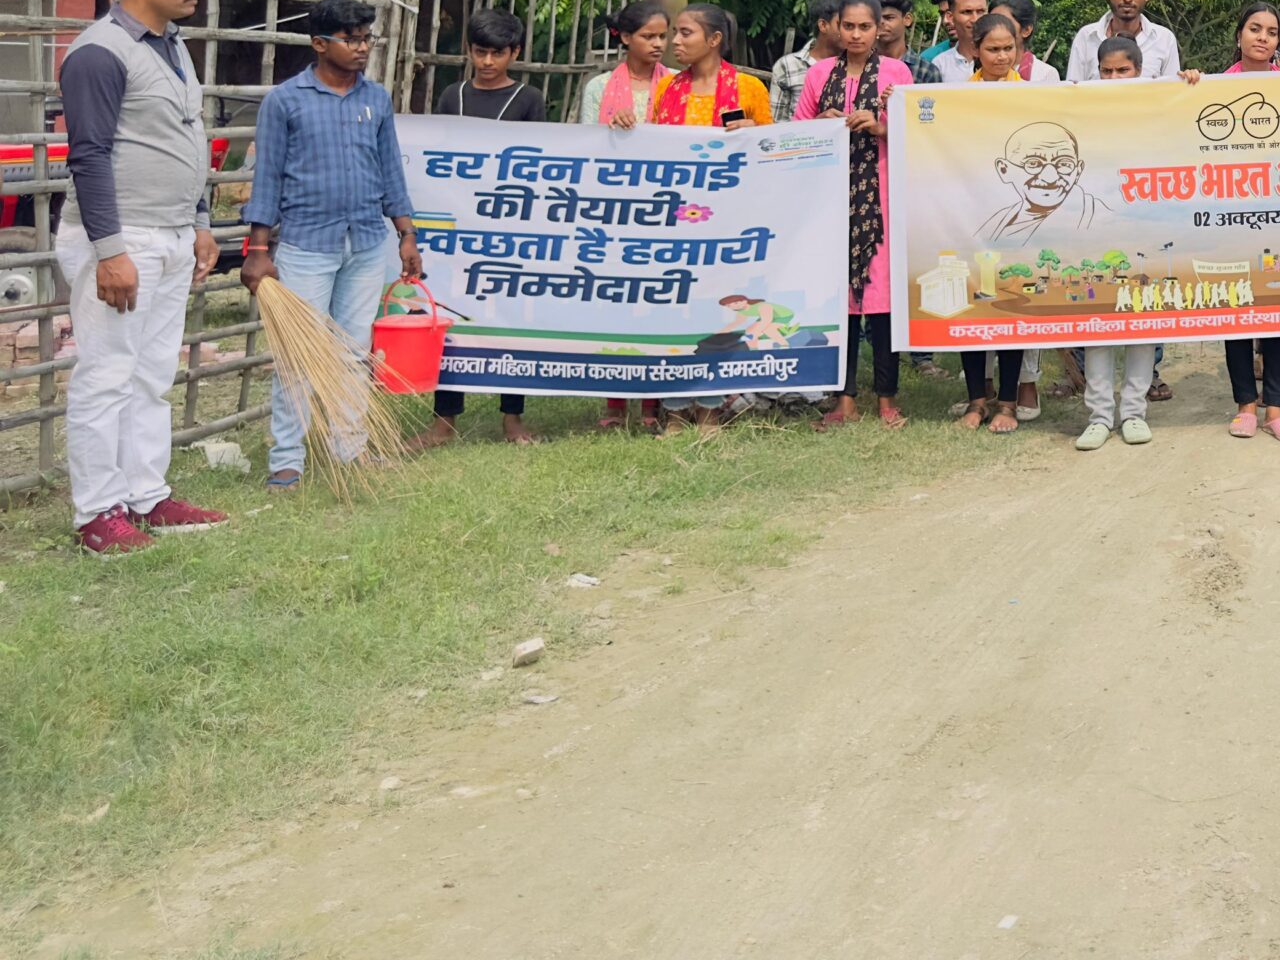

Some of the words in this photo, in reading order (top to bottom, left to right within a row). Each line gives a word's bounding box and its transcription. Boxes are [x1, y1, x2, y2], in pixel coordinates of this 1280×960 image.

[1206, 118, 1229, 128] स्वच्छ
[1249, 117, 1271, 126] भारत
[423, 150, 491, 179] हर
[495, 146, 590, 184] दिन
[594, 152, 748, 191] सफाई
[1119, 165, 1197, 204] स्वच्छ
[1201, 161, 1272, 200] भारत
[474, 184, 540, 221] की
[544, 186, 687, 226] तैयारी
[1194, 211, 1211, 227] 02
[574, 226, 614, 264] है
[618, 227, 776, 266] हमारी
[464, 261, 698, 304] ज़िम्मेदारी
[1017, 320, 1074, 336] हेमलता
[1076, 317, 1126, 333] महिला
[1129, 317, 1176, 331] समाज
[1179, 314, 1237, 329] कल्याण
[440, 355, 487, 374] मलता
[488, 354, 537, 377] महिला
[539, 361, 586, 379] समाज
[588, 363, 647, 381] कल्याण
[649, 359, 715, 381] संस्थान,
[718, 354, 799, 381] समस्तीपुर
